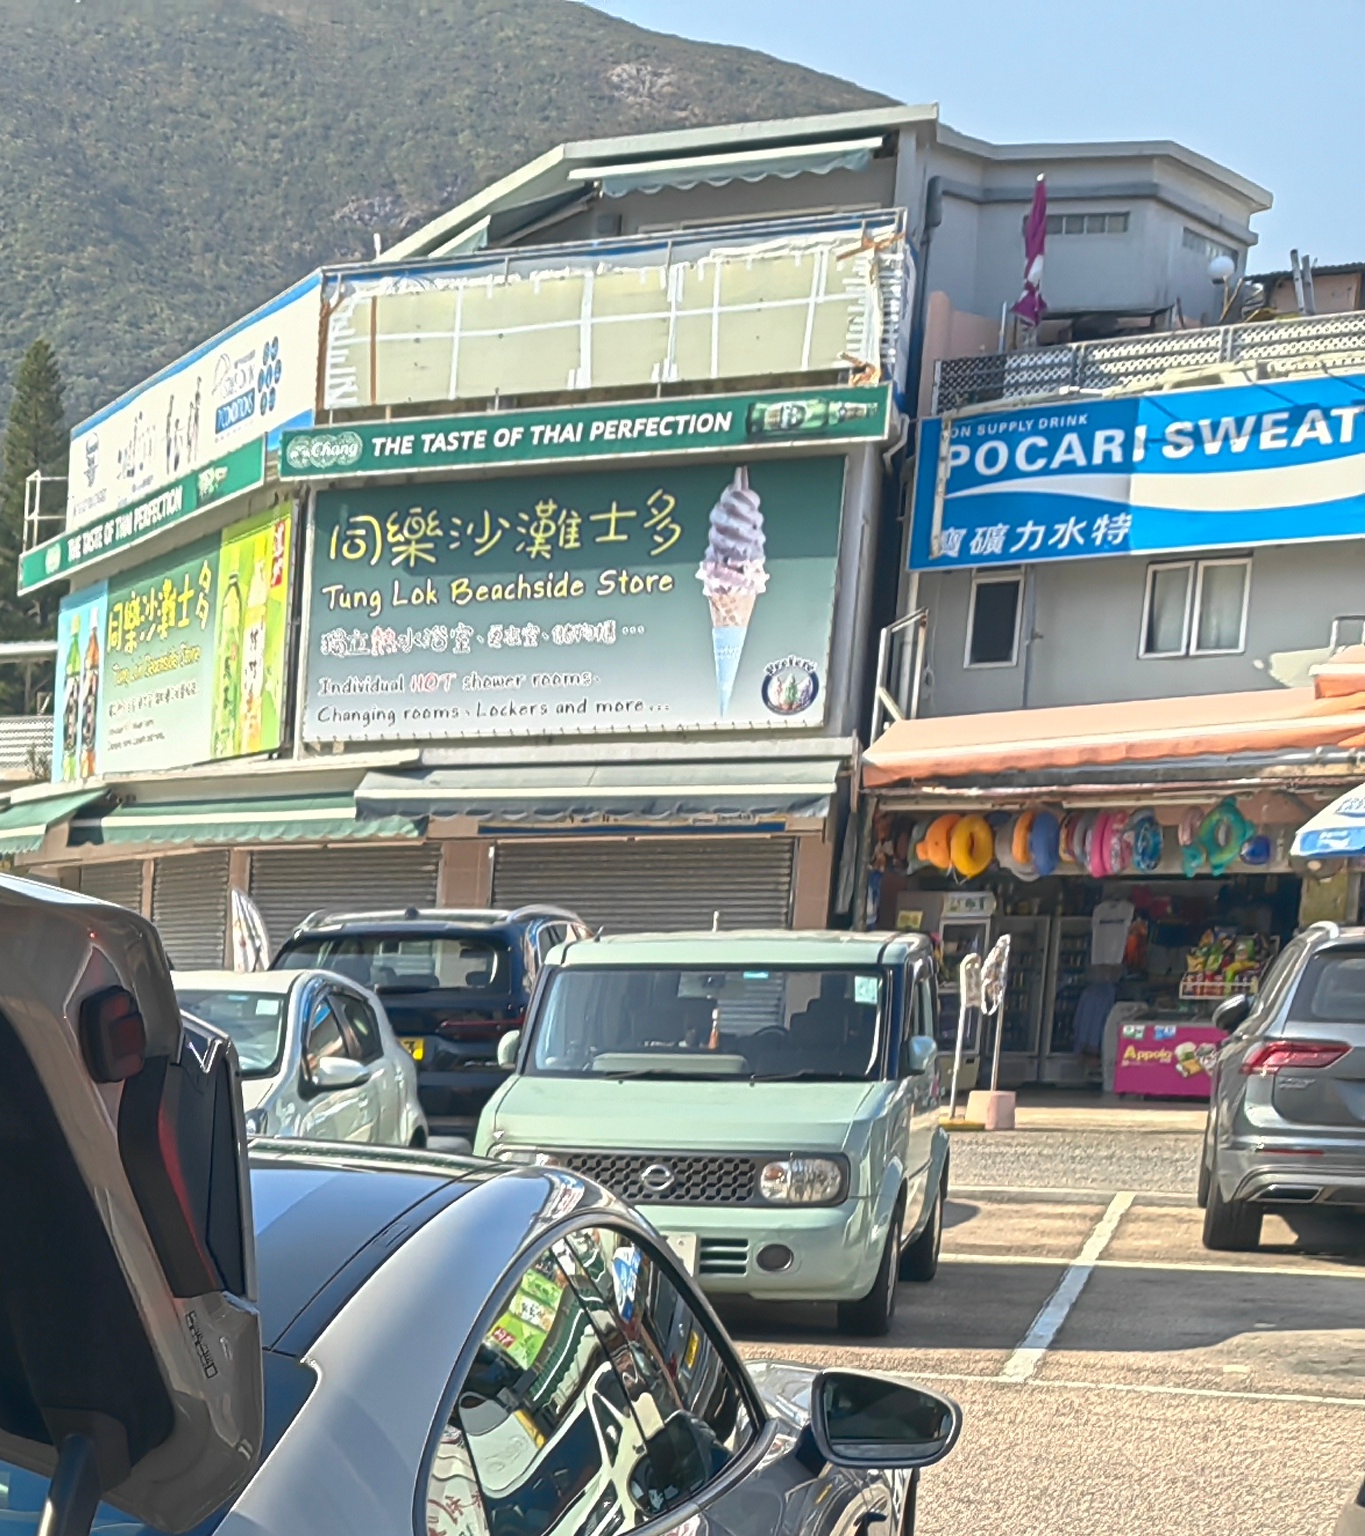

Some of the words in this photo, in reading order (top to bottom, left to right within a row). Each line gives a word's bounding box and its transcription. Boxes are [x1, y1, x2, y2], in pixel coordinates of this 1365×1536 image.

[371, 435, 415, 458] THE
[420, 429, 488, 454] TASTE
[492, 427, 524, 448] OF
[530, 422, 584, 446] THAI
[589, 411, 733, 442] PERFECTION
[945, 424, 1148, 479] POCARI
[1161, 405, 1365, 459] SWEAT
[950, 426, 972, 439] ON
[976, 419, 1035, 437] SUPPLY
[1038, 413, 1089, 431] DRINK
[311, 441, 359, 459] Chang
[329, 488, 682, 567] 同樂沙灘士多
[940, 511, 1133, 558] 寶礦力水特
[322, 584, 383, 617] Tung
[392, 578, 438, 607] Lok
[451, 573, 585, 605] Beachside
[596, 569, 674, 596] Store
[318, 673, 405, 696] Individual
[411, 671, 457, 693] HOT
[462, 670, 525, 692] shower
[317, 705, 396, 728] Changing
[476, 701, 549, 718] Lockers
[555, 697, 588, 715] and
